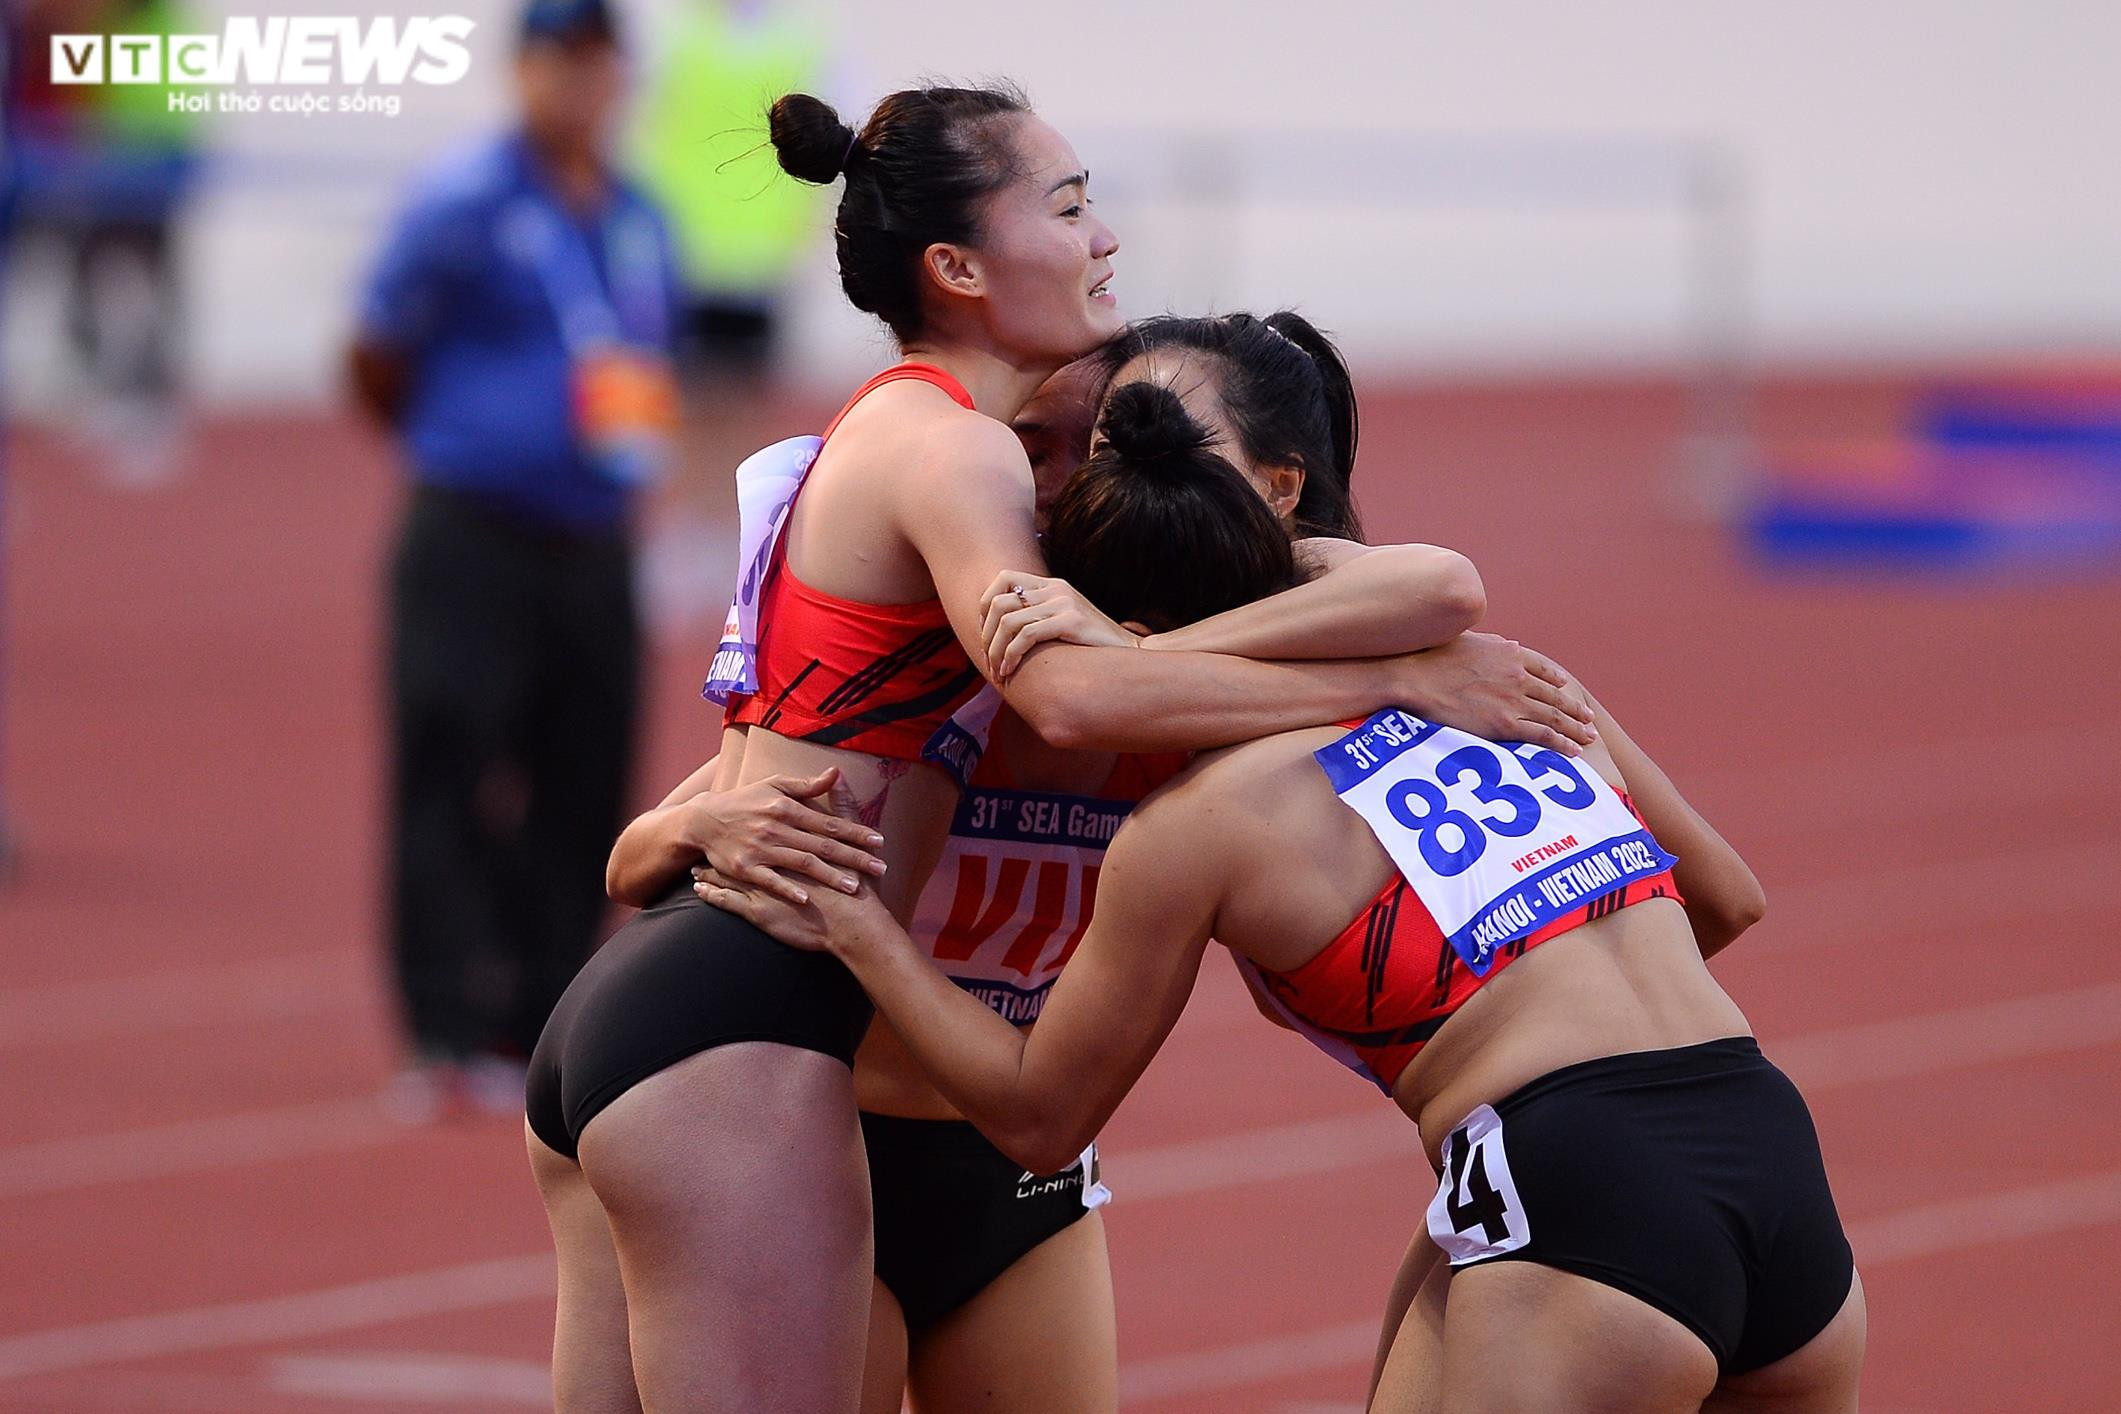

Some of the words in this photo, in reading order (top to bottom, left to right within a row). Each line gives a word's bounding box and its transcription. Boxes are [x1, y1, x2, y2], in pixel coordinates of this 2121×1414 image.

[1372, 711, 1428, 747] SEA
[971, 795, 1014, 829] 31ST
[1017, 800, 1060, 835] SEA
[1067, 804, 1131, 840] Gam
[1385, 745, 1596, 877] 835
[1511, 835, 1579, 873] VIETNAM
[1471, 893, 1538, 954] HANOI
[1537, 851, 1621, 909] VIETNAM
[1611, 840, 1657, 875] 2022
[1447, 1126, 1508, 1246] 4
